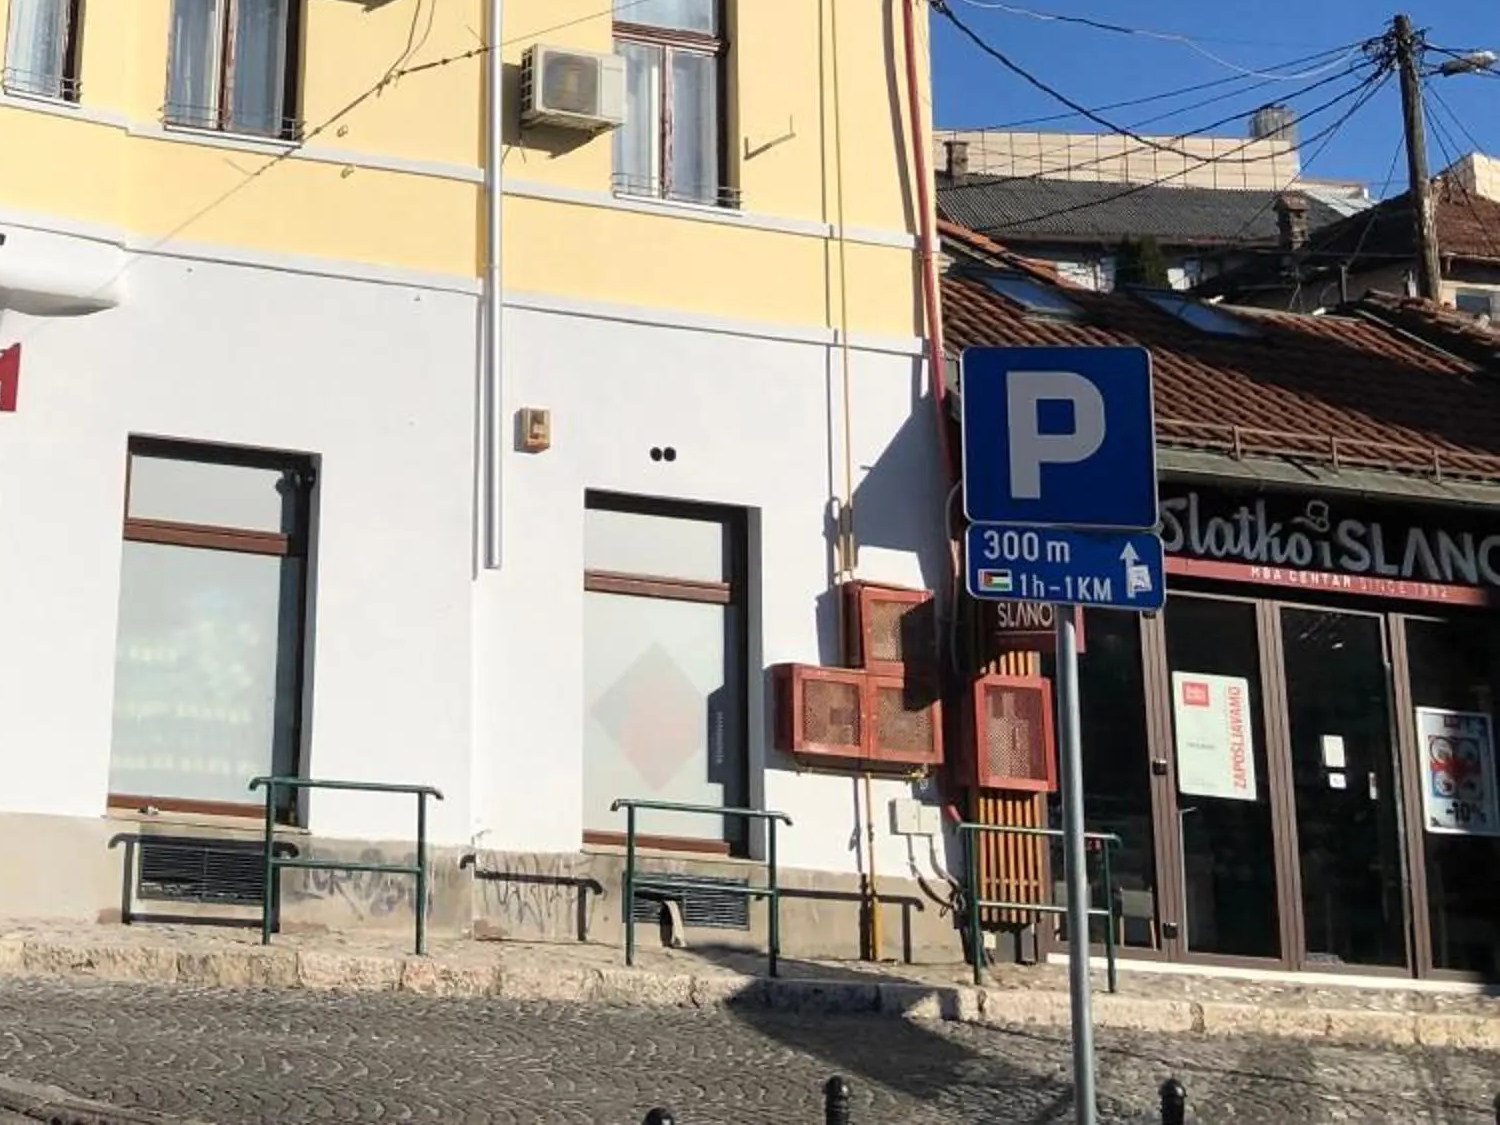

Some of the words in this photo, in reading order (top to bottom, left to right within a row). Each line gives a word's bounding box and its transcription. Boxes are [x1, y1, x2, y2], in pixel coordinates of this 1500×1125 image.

[1006, 371, 1106, 499] P
[983, 530, 1040, 562] 300
[1047, 539, 1070, 563] m
[1289, 570, 1351, 588] CENTAR
[1359, 577, 1407, 595] SINCE
[997, 601, 1053, 628] SLANO
